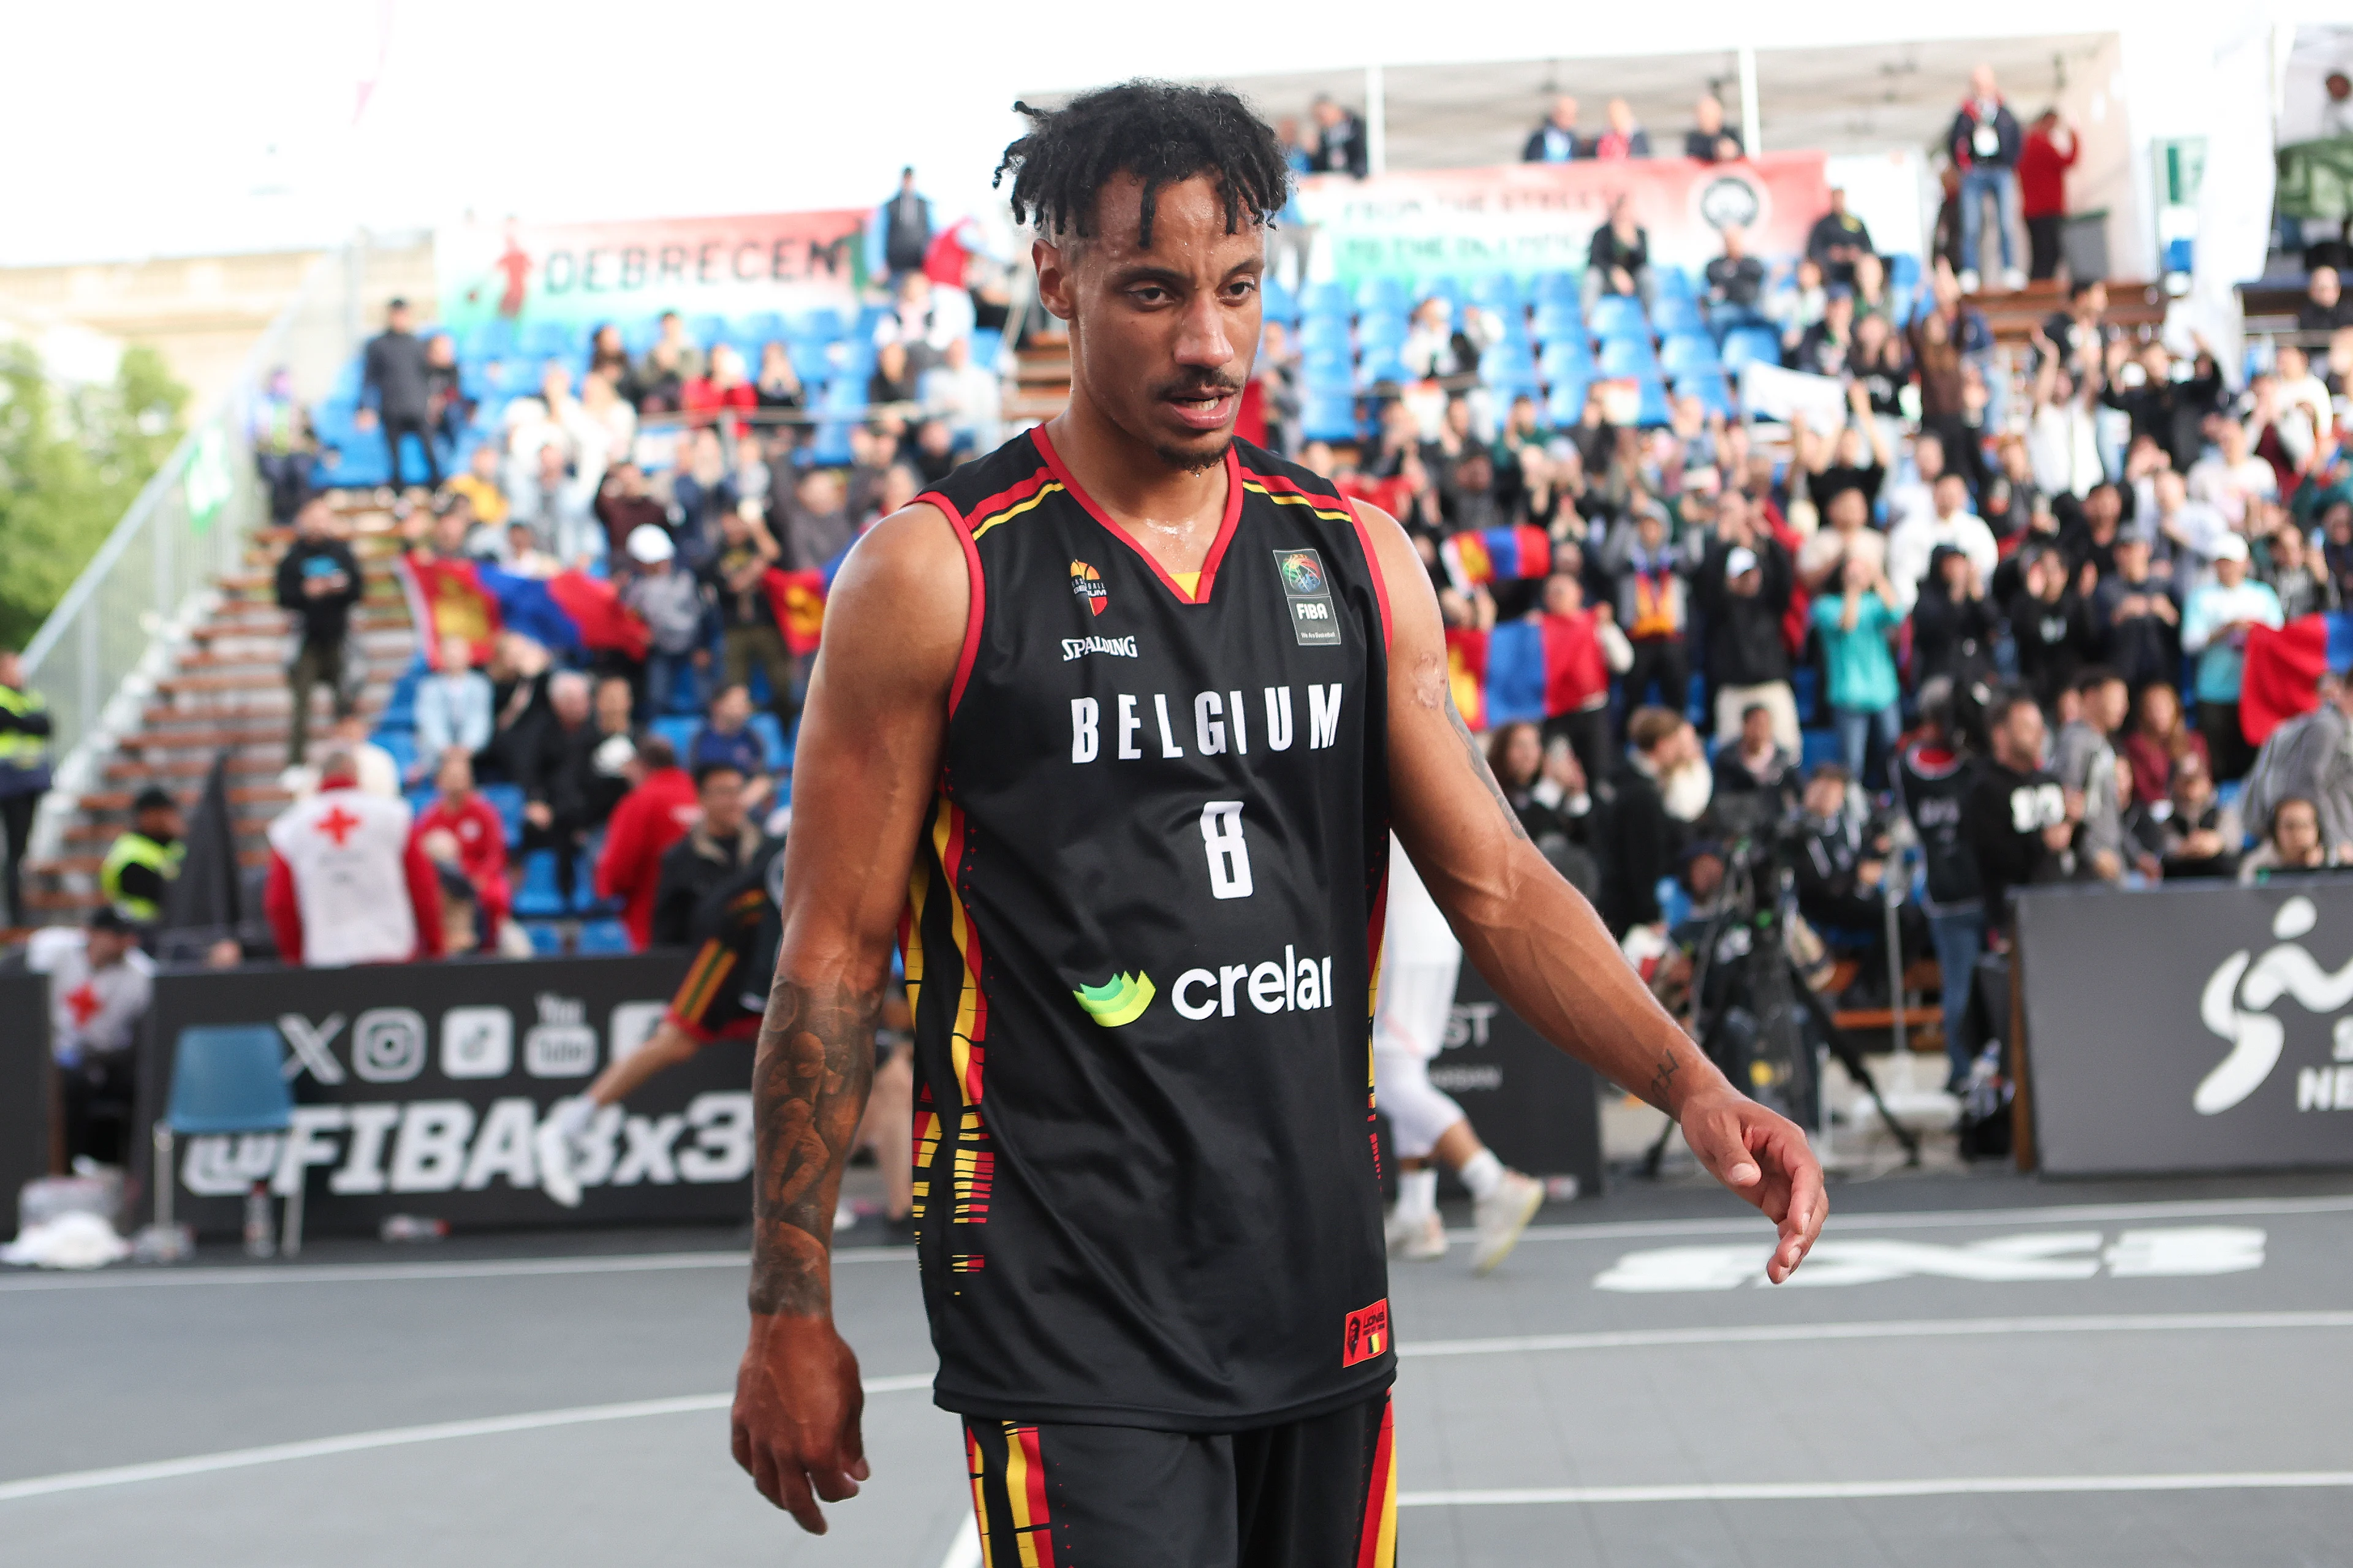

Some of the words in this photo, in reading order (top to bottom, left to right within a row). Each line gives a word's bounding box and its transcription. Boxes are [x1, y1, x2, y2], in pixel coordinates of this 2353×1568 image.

[544, 235, 841, 297] DEBRECEN
[1296, 603, 1328, 620] FIBA
[1061, 635, 1139, 662] SPALDING
[1070, 683, 1343, 763] BELGIUM
[1199, 800, 1254, 900] 8
